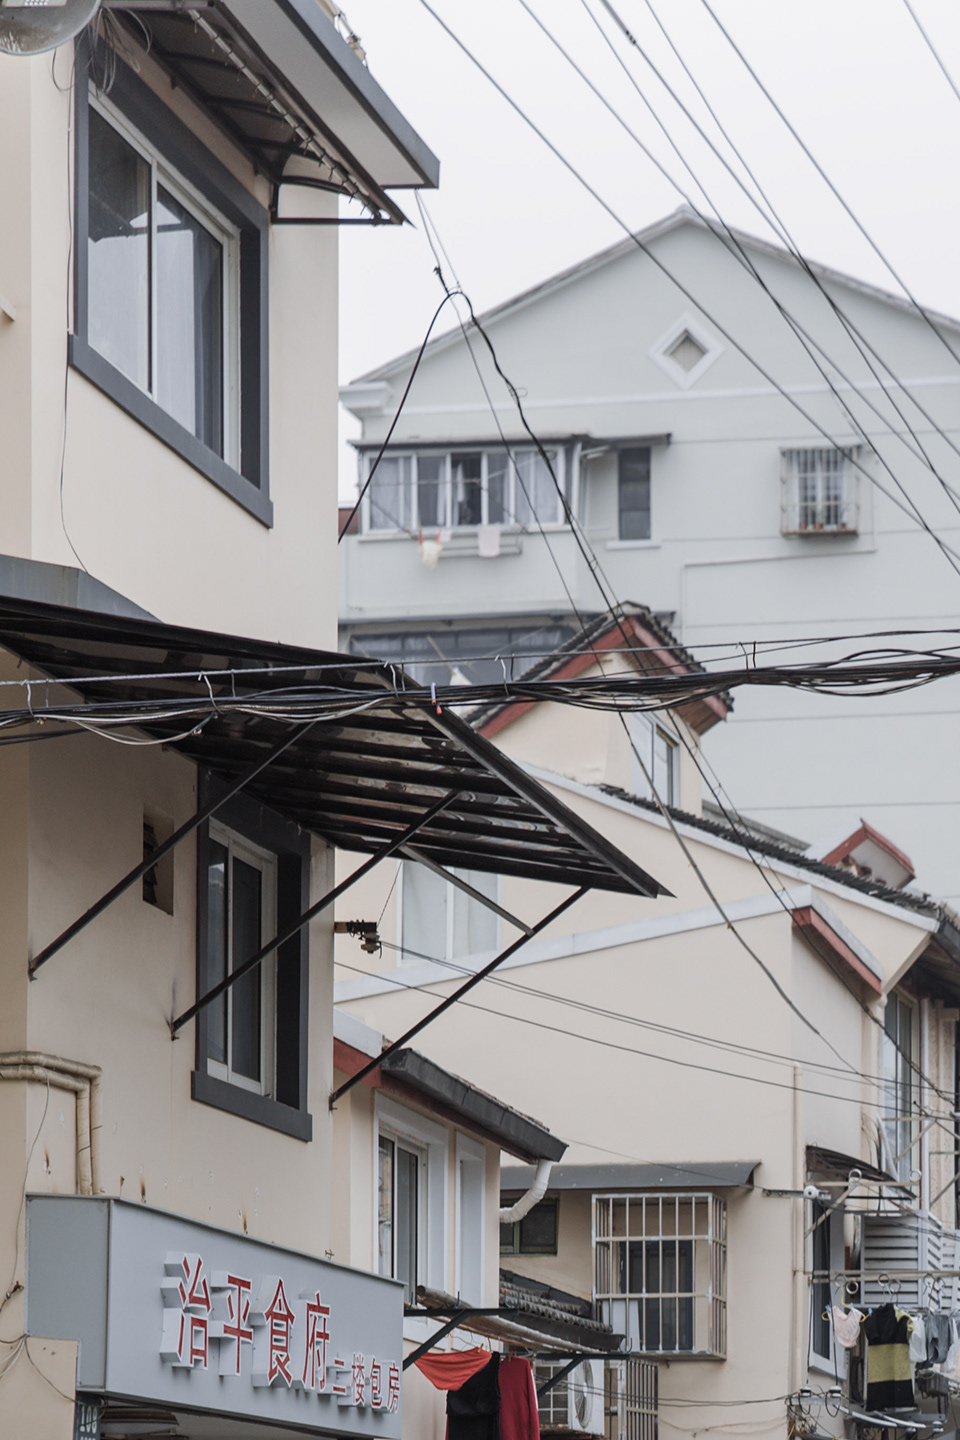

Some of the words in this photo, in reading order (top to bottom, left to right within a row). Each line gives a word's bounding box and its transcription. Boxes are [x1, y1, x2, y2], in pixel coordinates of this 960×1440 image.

[174, 1254, 331, 1392] 治平食府
[332, 1352, 400, 1414] 二楼包房
[80, 1405, 98, 1434] 108
